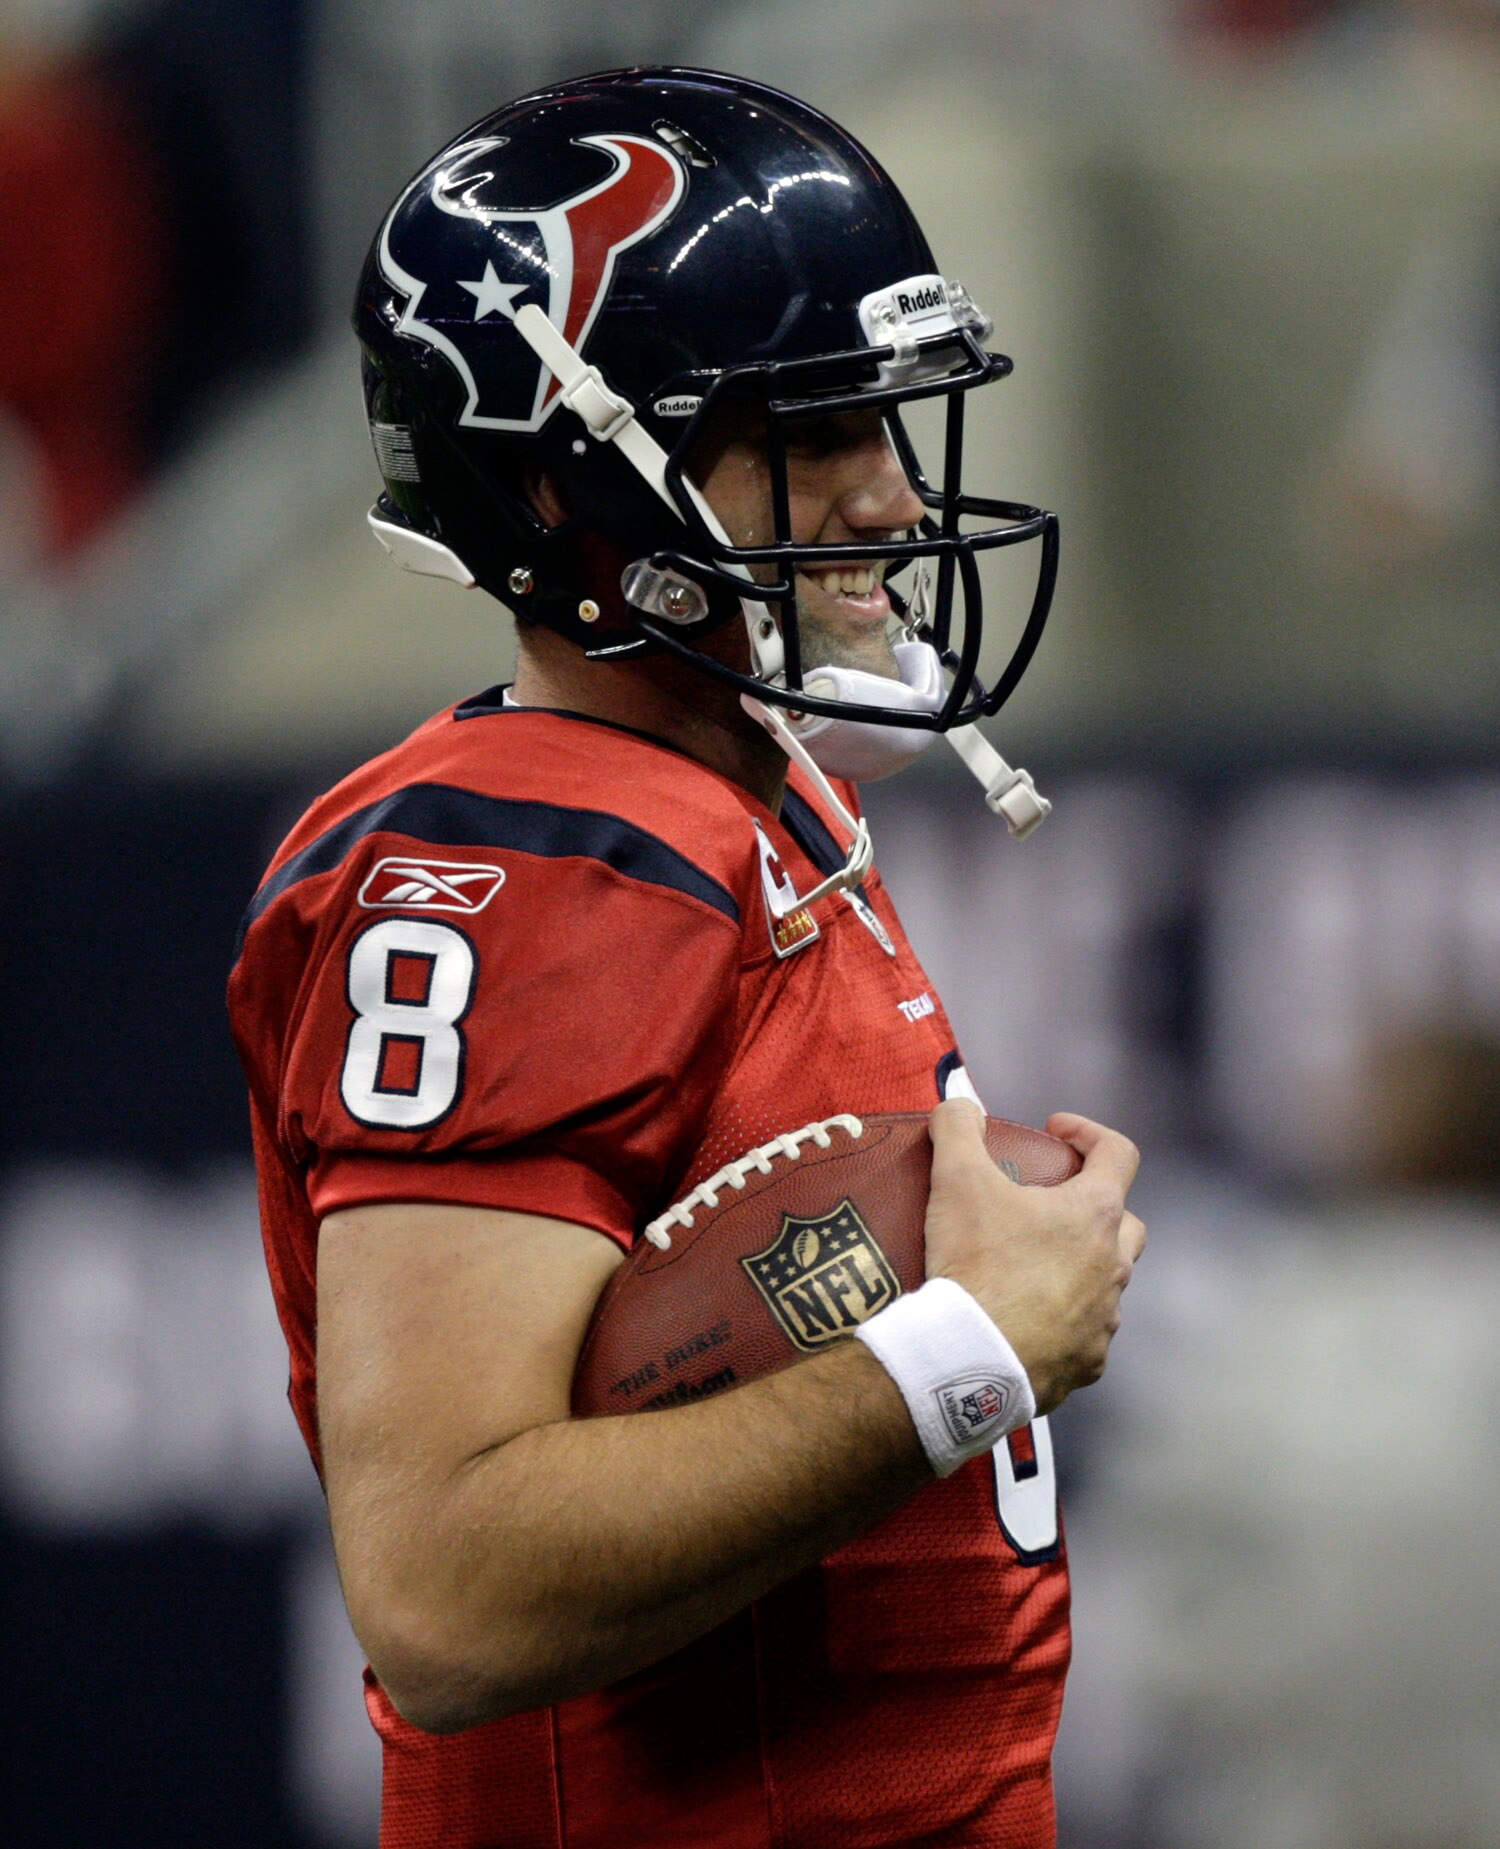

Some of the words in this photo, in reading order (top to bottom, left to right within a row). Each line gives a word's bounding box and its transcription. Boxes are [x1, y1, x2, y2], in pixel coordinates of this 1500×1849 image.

[897, 283, 947, 315] Riddell
[658, 400, 701, 412] Riddel
[756, 820, 799, 919] C
[339, 914, 481, 1133] 8
[781, 1254, 890, 1338] NFL
[943, 1390, 973, 1441] EQUIPMENT
[976, 1387, 1000, 1418] NFL
